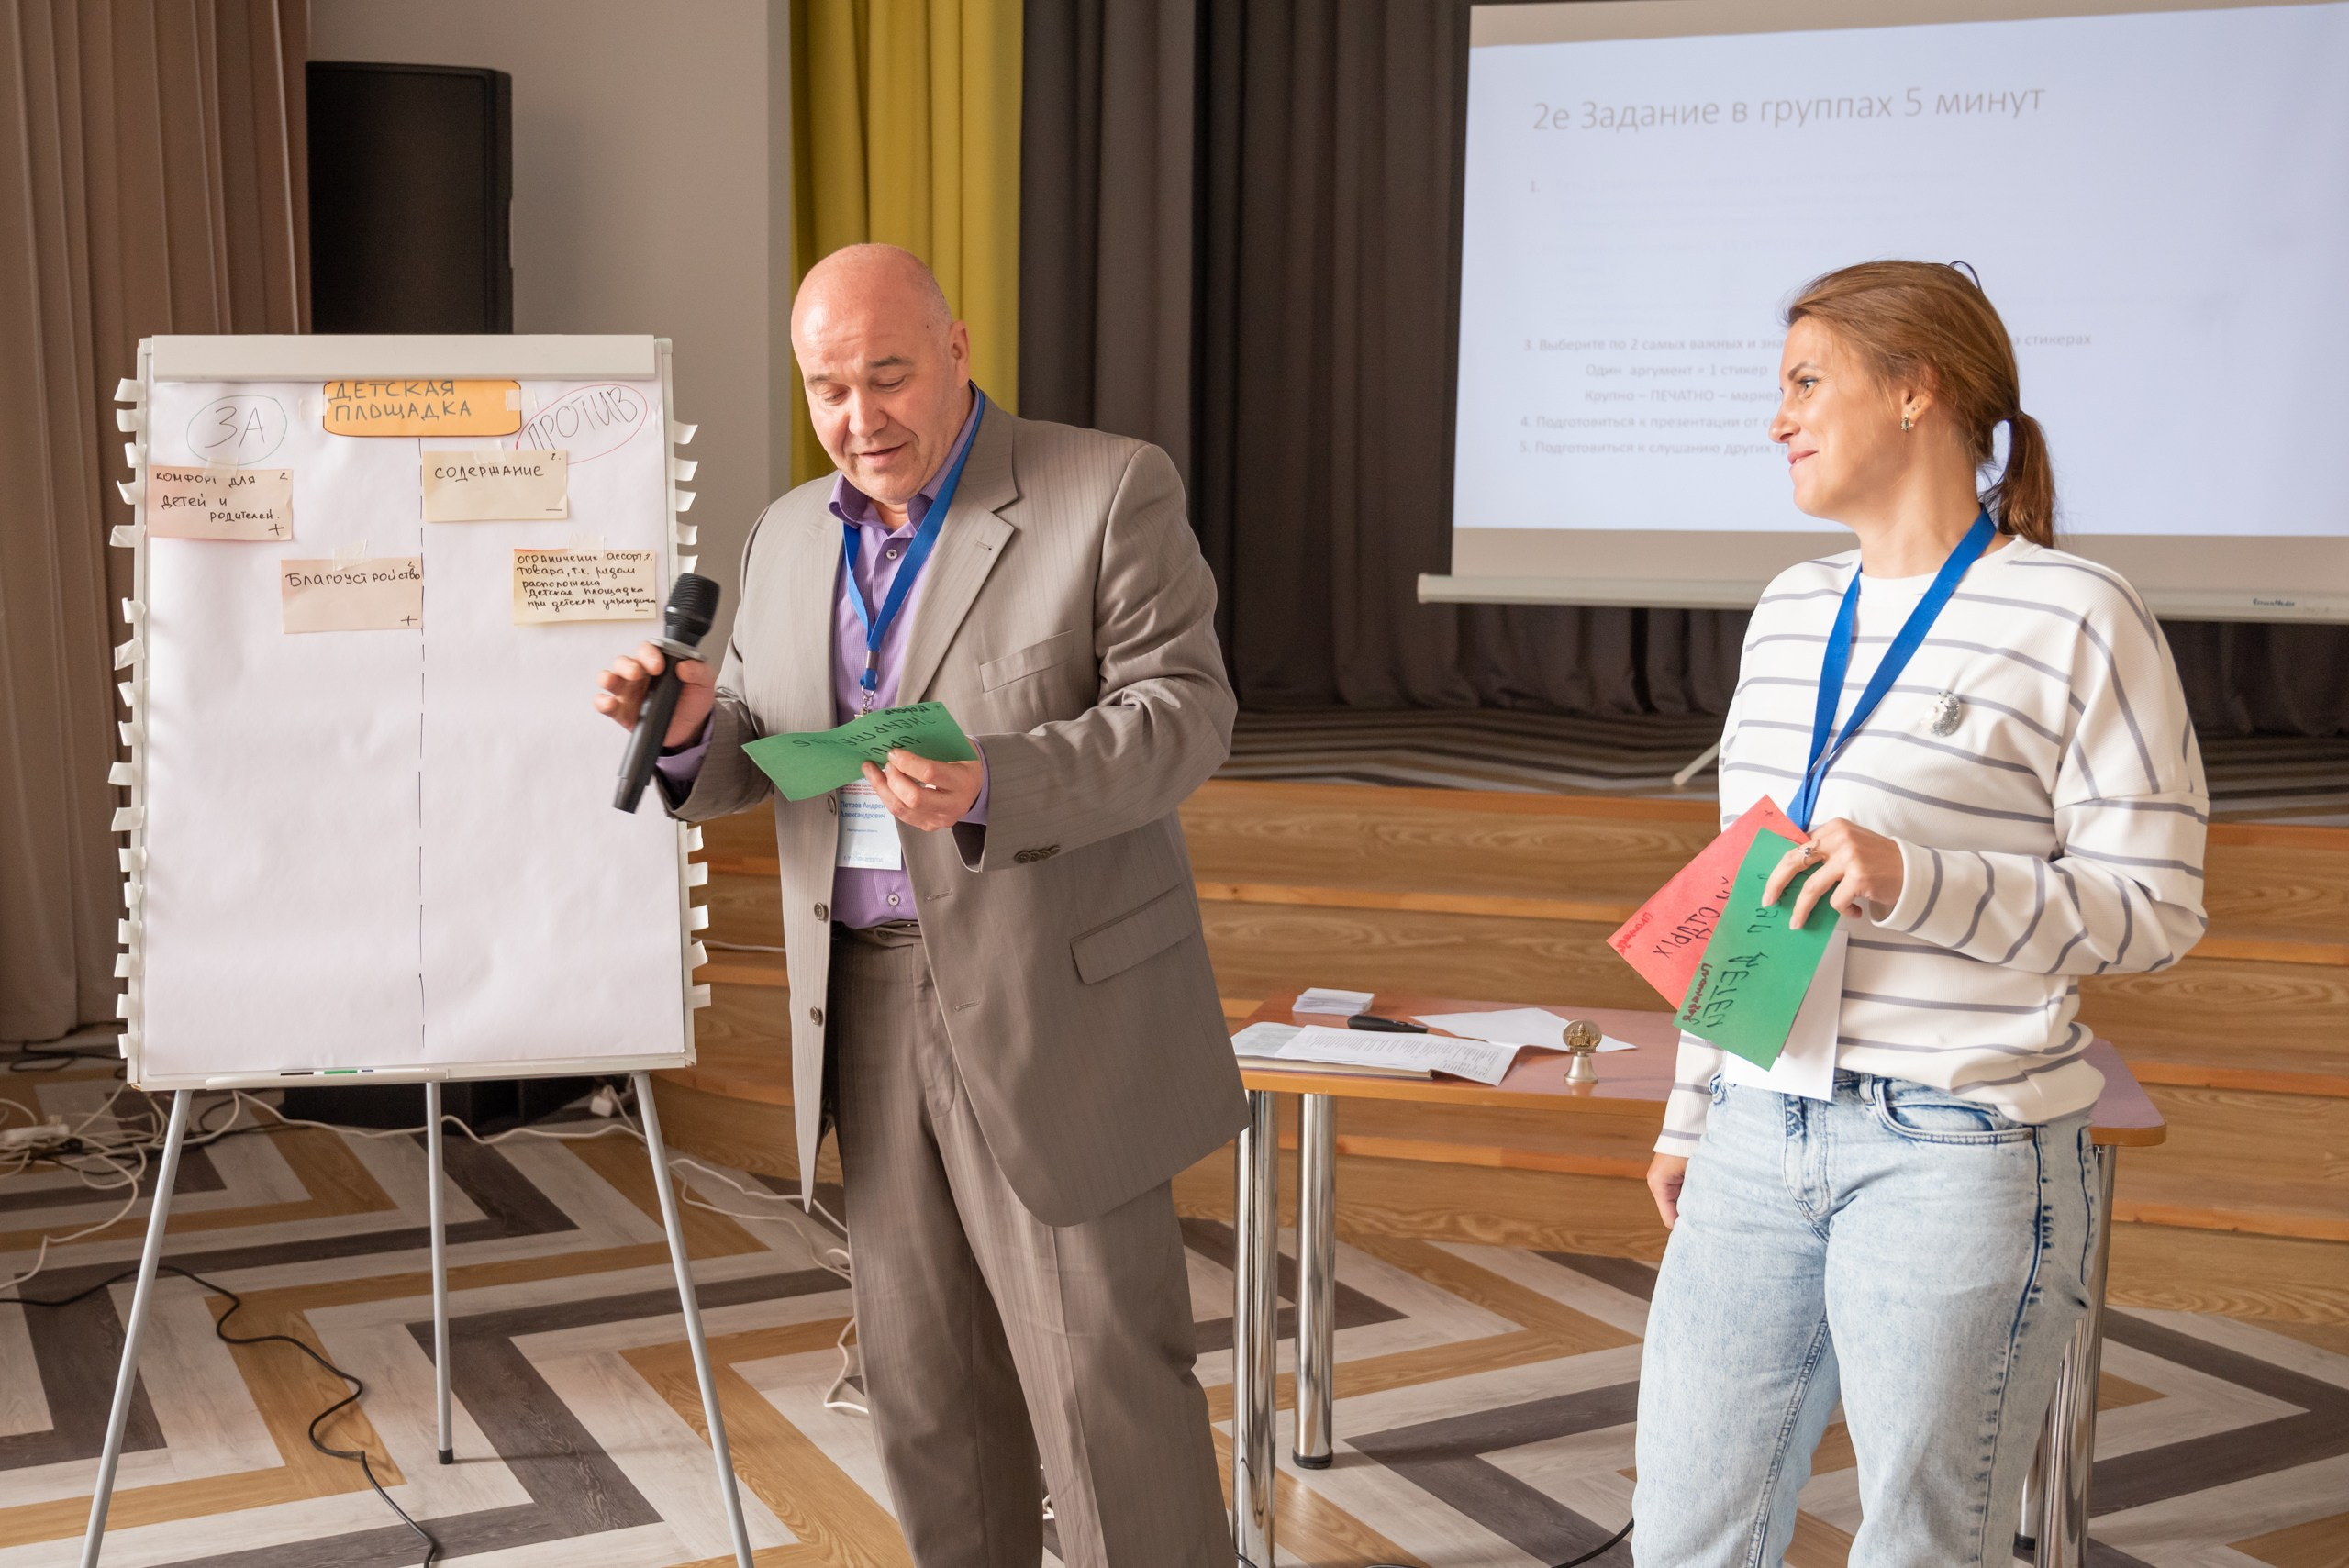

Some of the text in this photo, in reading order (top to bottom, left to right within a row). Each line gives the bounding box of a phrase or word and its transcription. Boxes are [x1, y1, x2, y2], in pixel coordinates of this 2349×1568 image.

[1532, 86, 2046, 133] 2е Задание в группах 5 минут
[1539, 338, 1606, 352] Выберите
[1609, 340, 1627, 350] по
[1630, 338, 1639, 351] 2
[1641, 340, 1686, 350] самых
[1688, 339, 1743, 350] важных
[1746, 339, 1756, 349] и
[1585, 363, 1622, 378] Один
[1629, 366, 1693, 378] аргумент
[1720, 365, 1767, 377] стикер
[328, 380, 455, 405] ДЕТСКАЯ
[1585, 390, 1635, 404] Крупно
[1650, 390, 1715, 402] ПЕЧАТНО
[335, 400, 472, 421] ПЛОЩАДКА
[528, 386, 638, 450] ПРОТИВ
[204, 406, 265, 449] ЗА
[1535, 415, 1636, 430] Подготовиться
[1639, 418, 1646, 428] к
[1650, 417, 1741, 430] презентации
[1743, 418, 1758, 428] от
[1534, 441, 1634, 456] Подготовиться
[1637, 445, 1645, 453] к
[1648, 444, 1721, 456] слушанию
[1723, 444, 1772, 457] других
